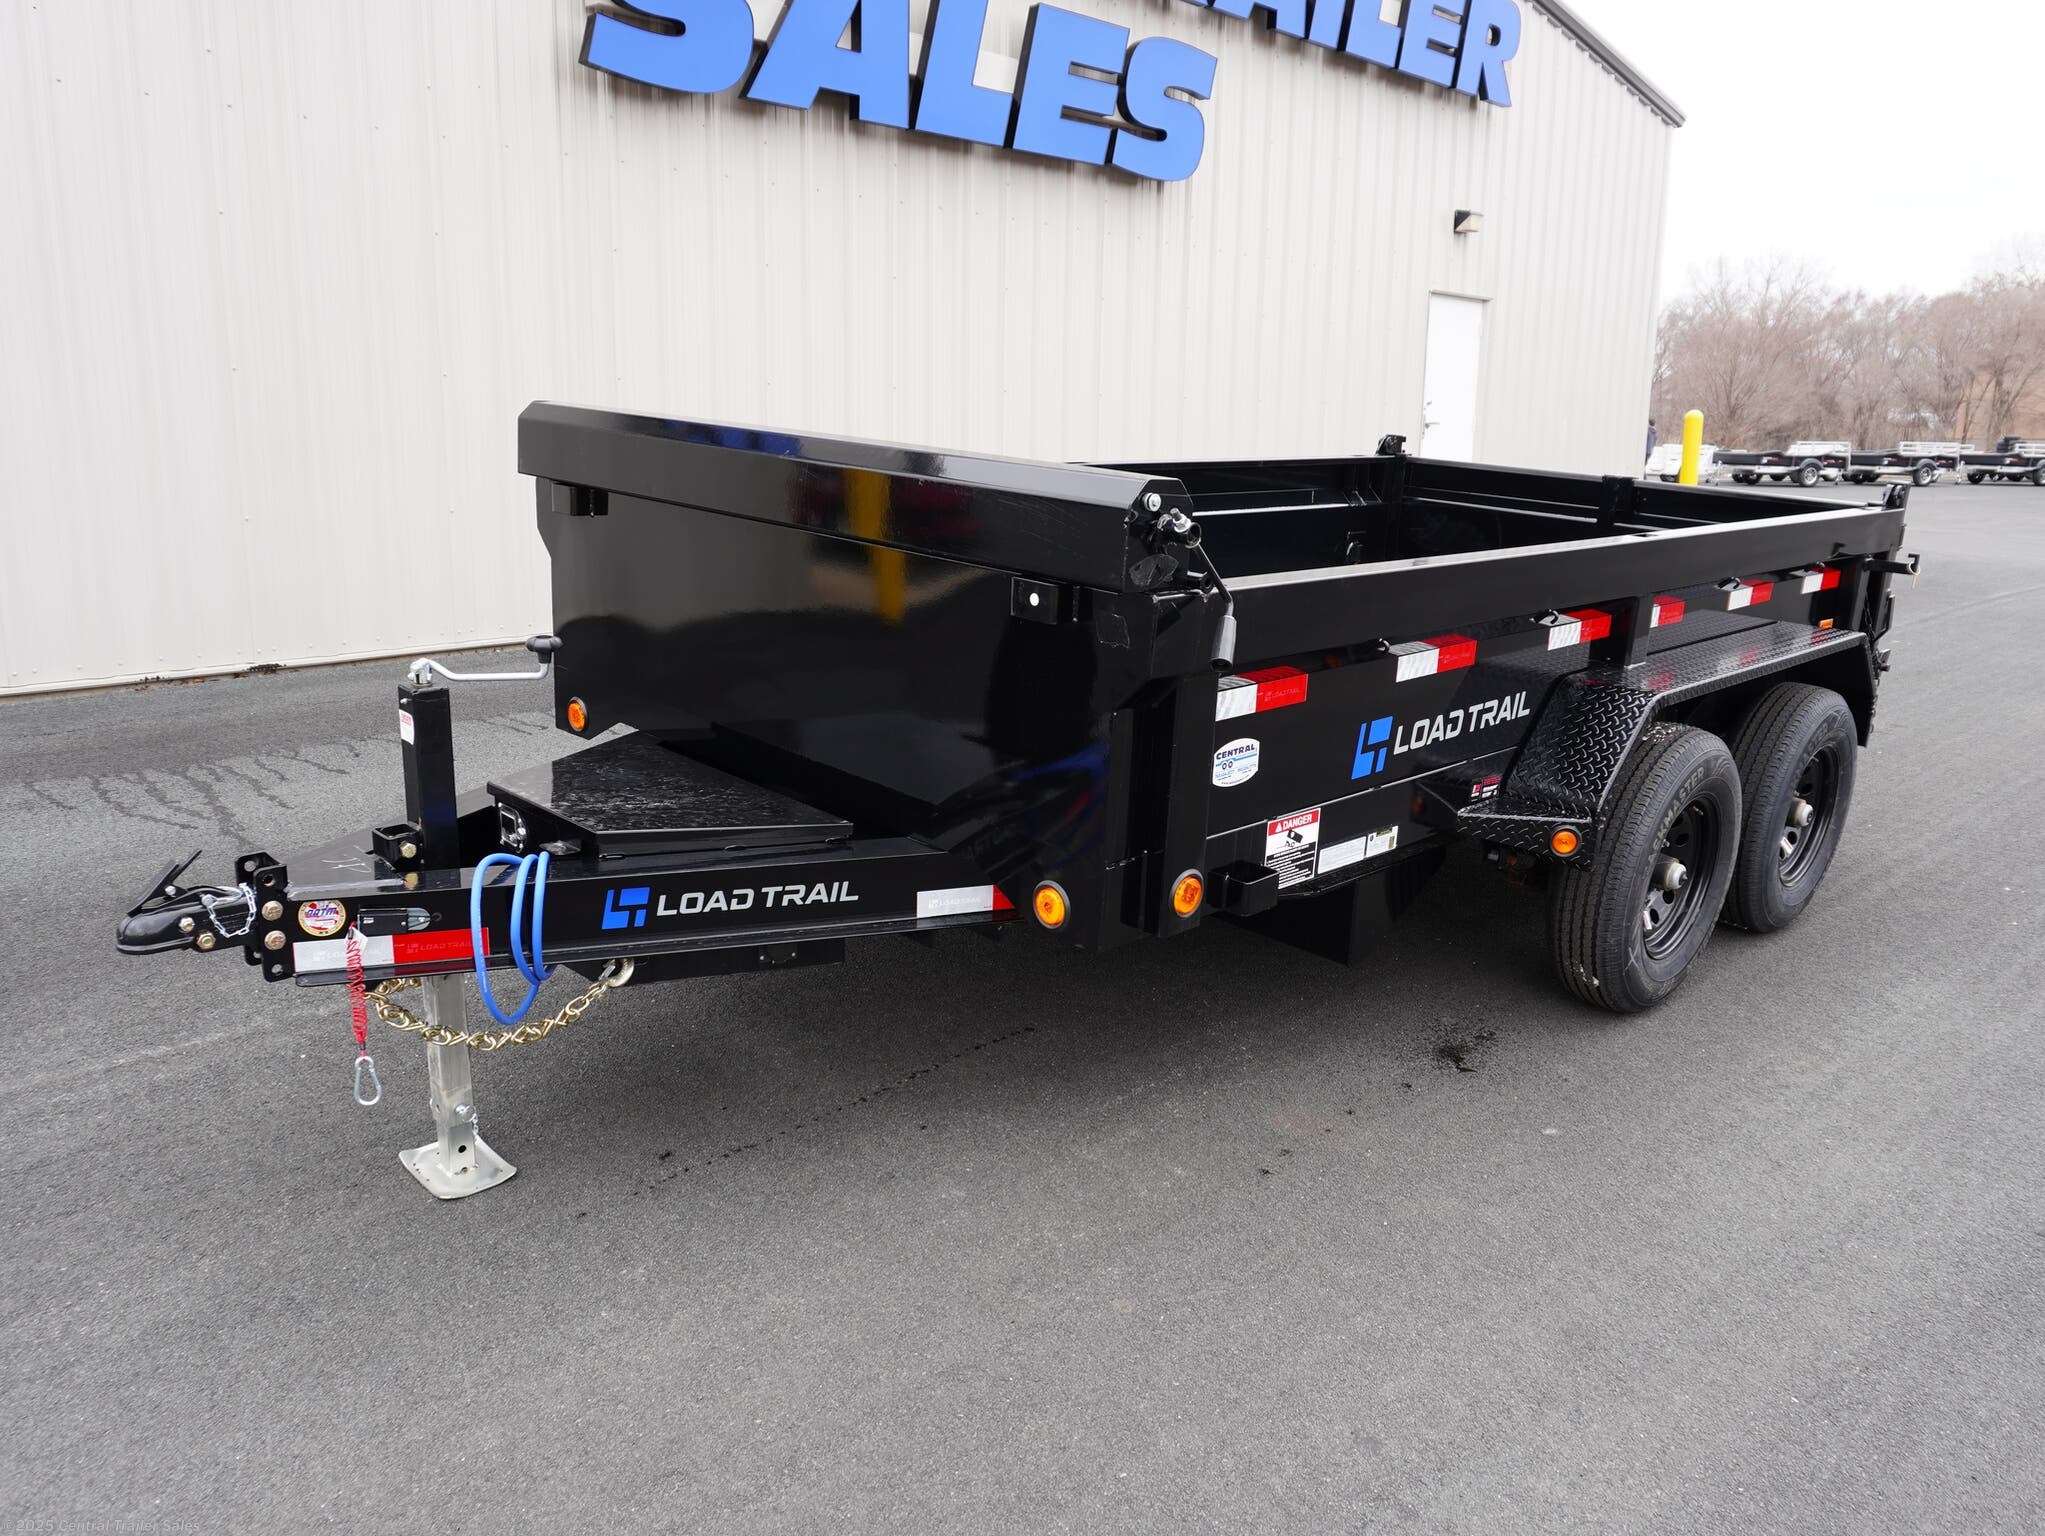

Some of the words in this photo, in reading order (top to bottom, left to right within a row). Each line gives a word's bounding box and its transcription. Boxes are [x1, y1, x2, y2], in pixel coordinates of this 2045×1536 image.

[579, 0, 1218, 181] SALES
[1394, 709, 1464, 755] LOAD
[1468, 691, 1530, 732] TRAIL
[1216, 743, 1255, 760] CENTRAL
[1283, 813, 1313, 829] DANGER
[657, 886, 753, 916] LOAD
[764, 881, 859, 908] TRAIL
